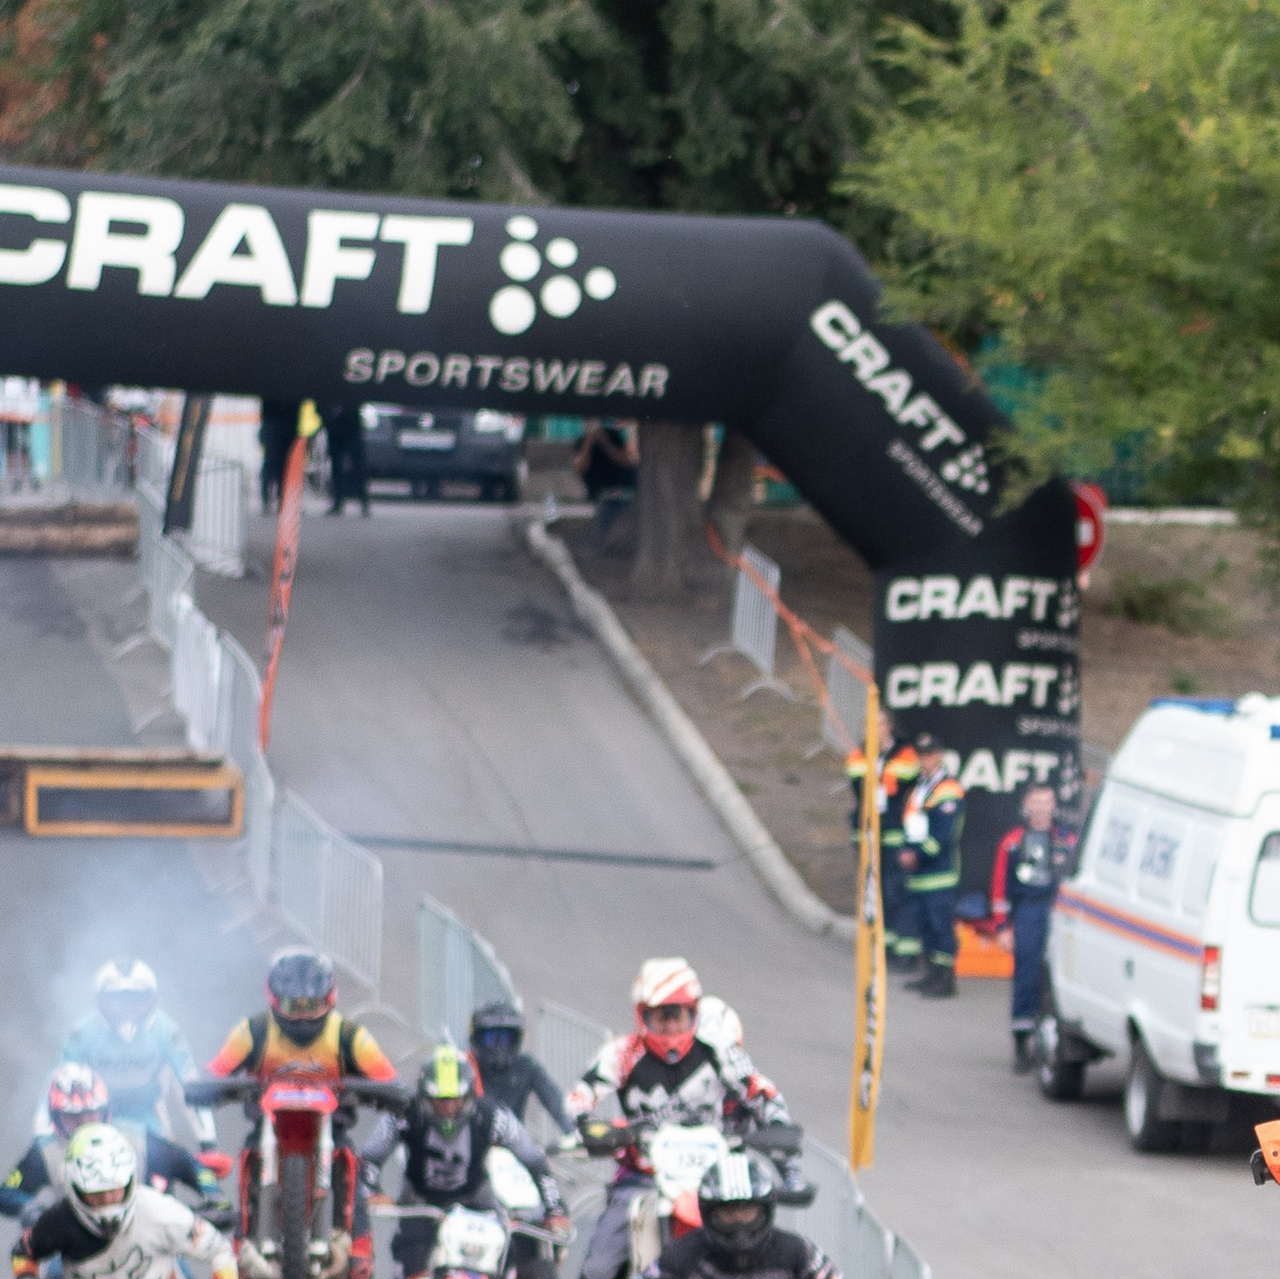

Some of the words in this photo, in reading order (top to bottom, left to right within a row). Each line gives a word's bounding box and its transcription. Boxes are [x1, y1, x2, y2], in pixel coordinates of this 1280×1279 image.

[0, 185, 474, 315] CRAFT
[343, 347, 669, 400] SPORTSWEAR
[810, 300, 966, 451] CRAFT
[885, 574, 1058, 622] CRAFT
[885, 661, 1058, 709] CRAFT
